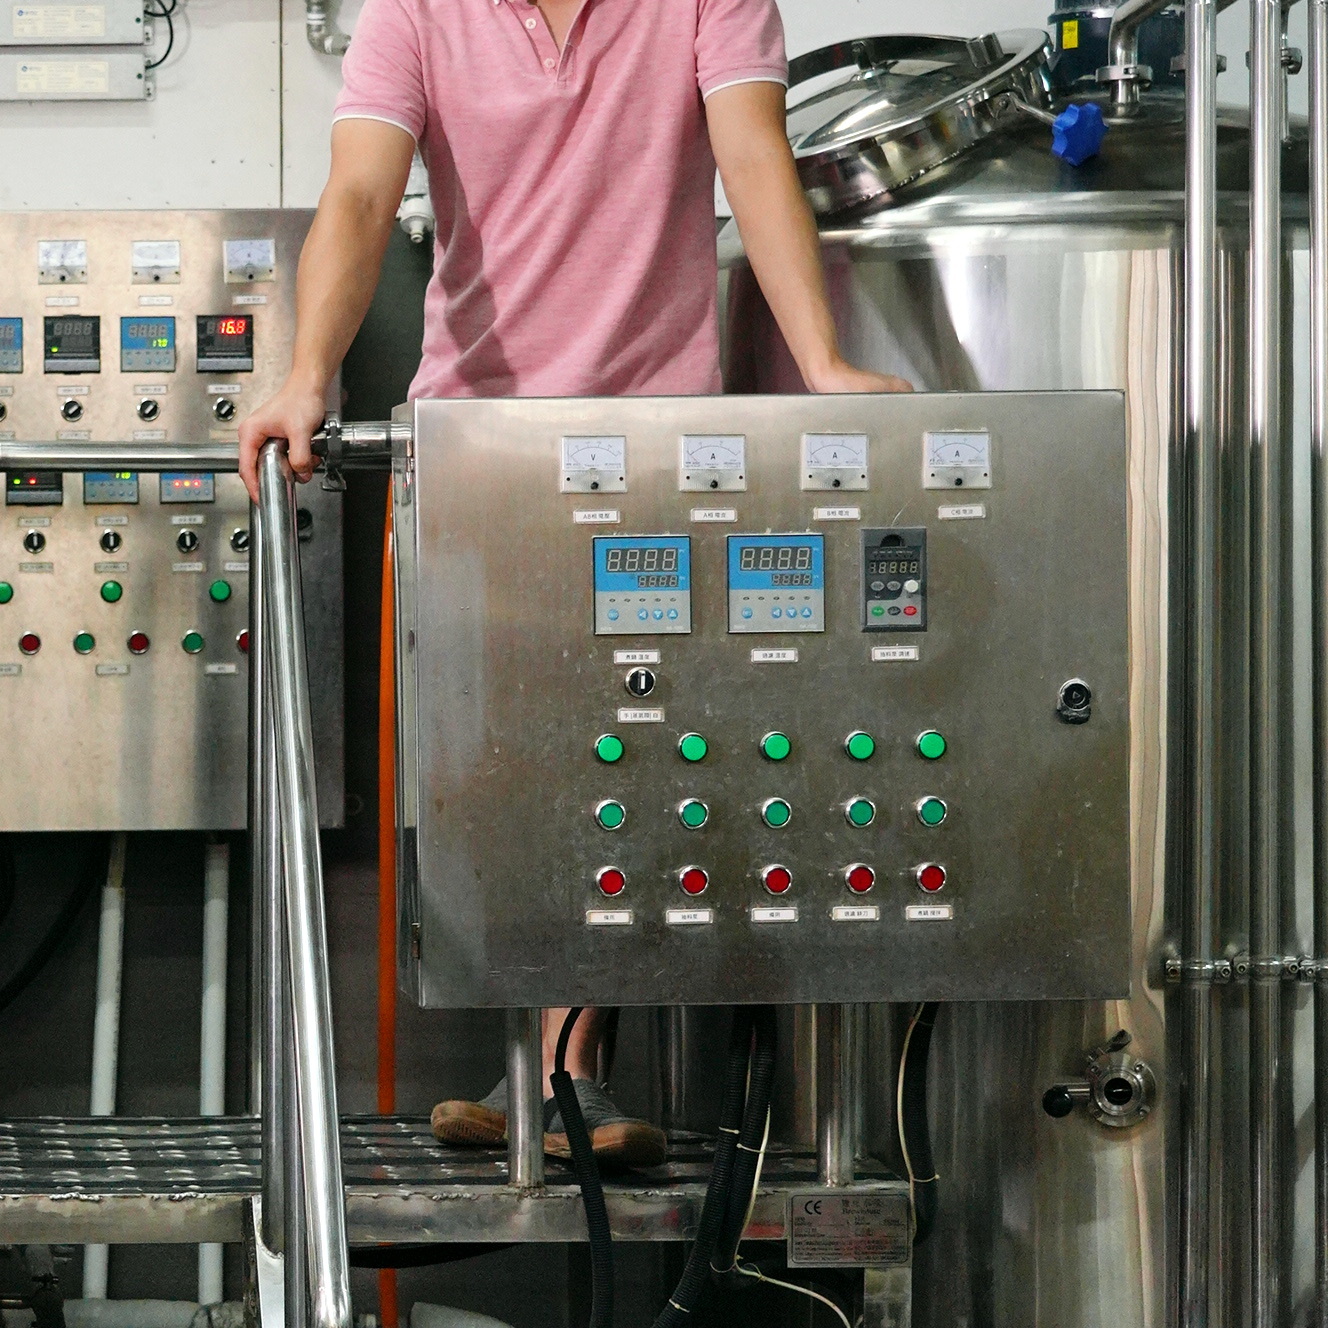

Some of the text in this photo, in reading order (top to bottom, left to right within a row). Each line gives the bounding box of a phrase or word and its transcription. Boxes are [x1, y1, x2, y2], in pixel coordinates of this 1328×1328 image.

[591, 453, 596, 461] V
[710, 452, 716, 460] A
[832, 451, 838, 459] A
[954, 449, 960, 457] A
